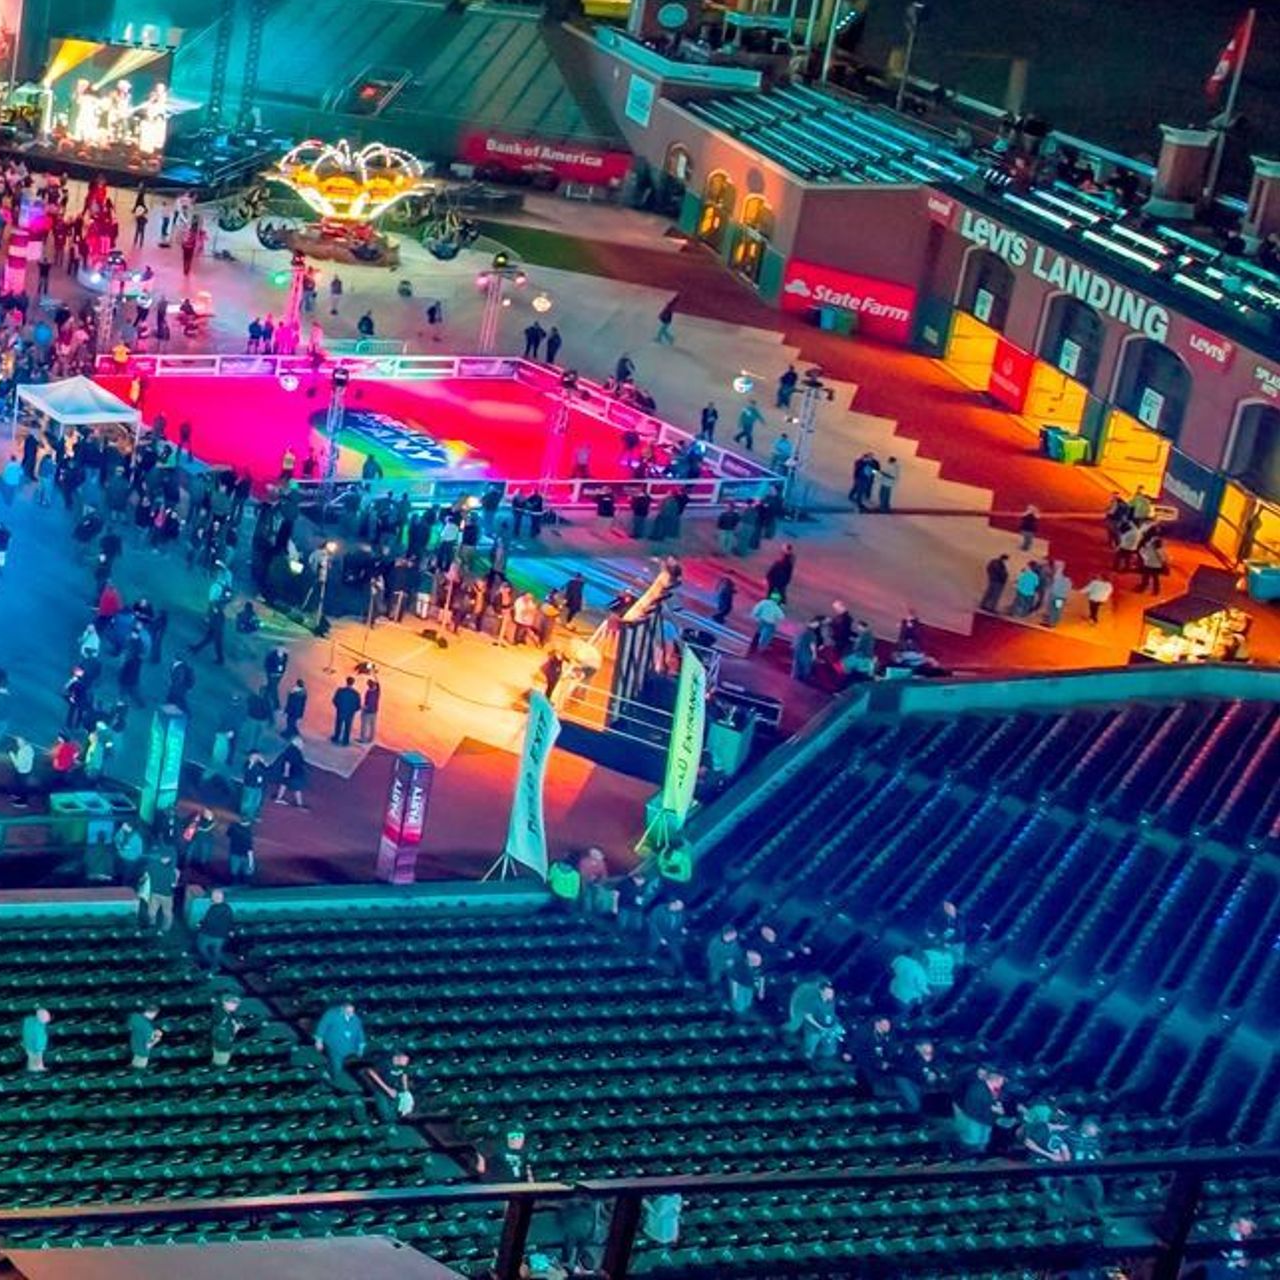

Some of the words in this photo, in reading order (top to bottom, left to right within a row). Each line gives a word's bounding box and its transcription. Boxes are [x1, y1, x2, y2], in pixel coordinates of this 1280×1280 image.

[485, 138, 523, 156] Bank
[524, 144, 541, 158] of
[540, 146, 603, 167] America
[812, 284, 861, 310] State
[860, 296, 910, 322] Farm
[1032, 246, 1169, 344] LANDING
[387, 777, 403, 819] PARTY
[407, 786, 424, 825] PARTY
